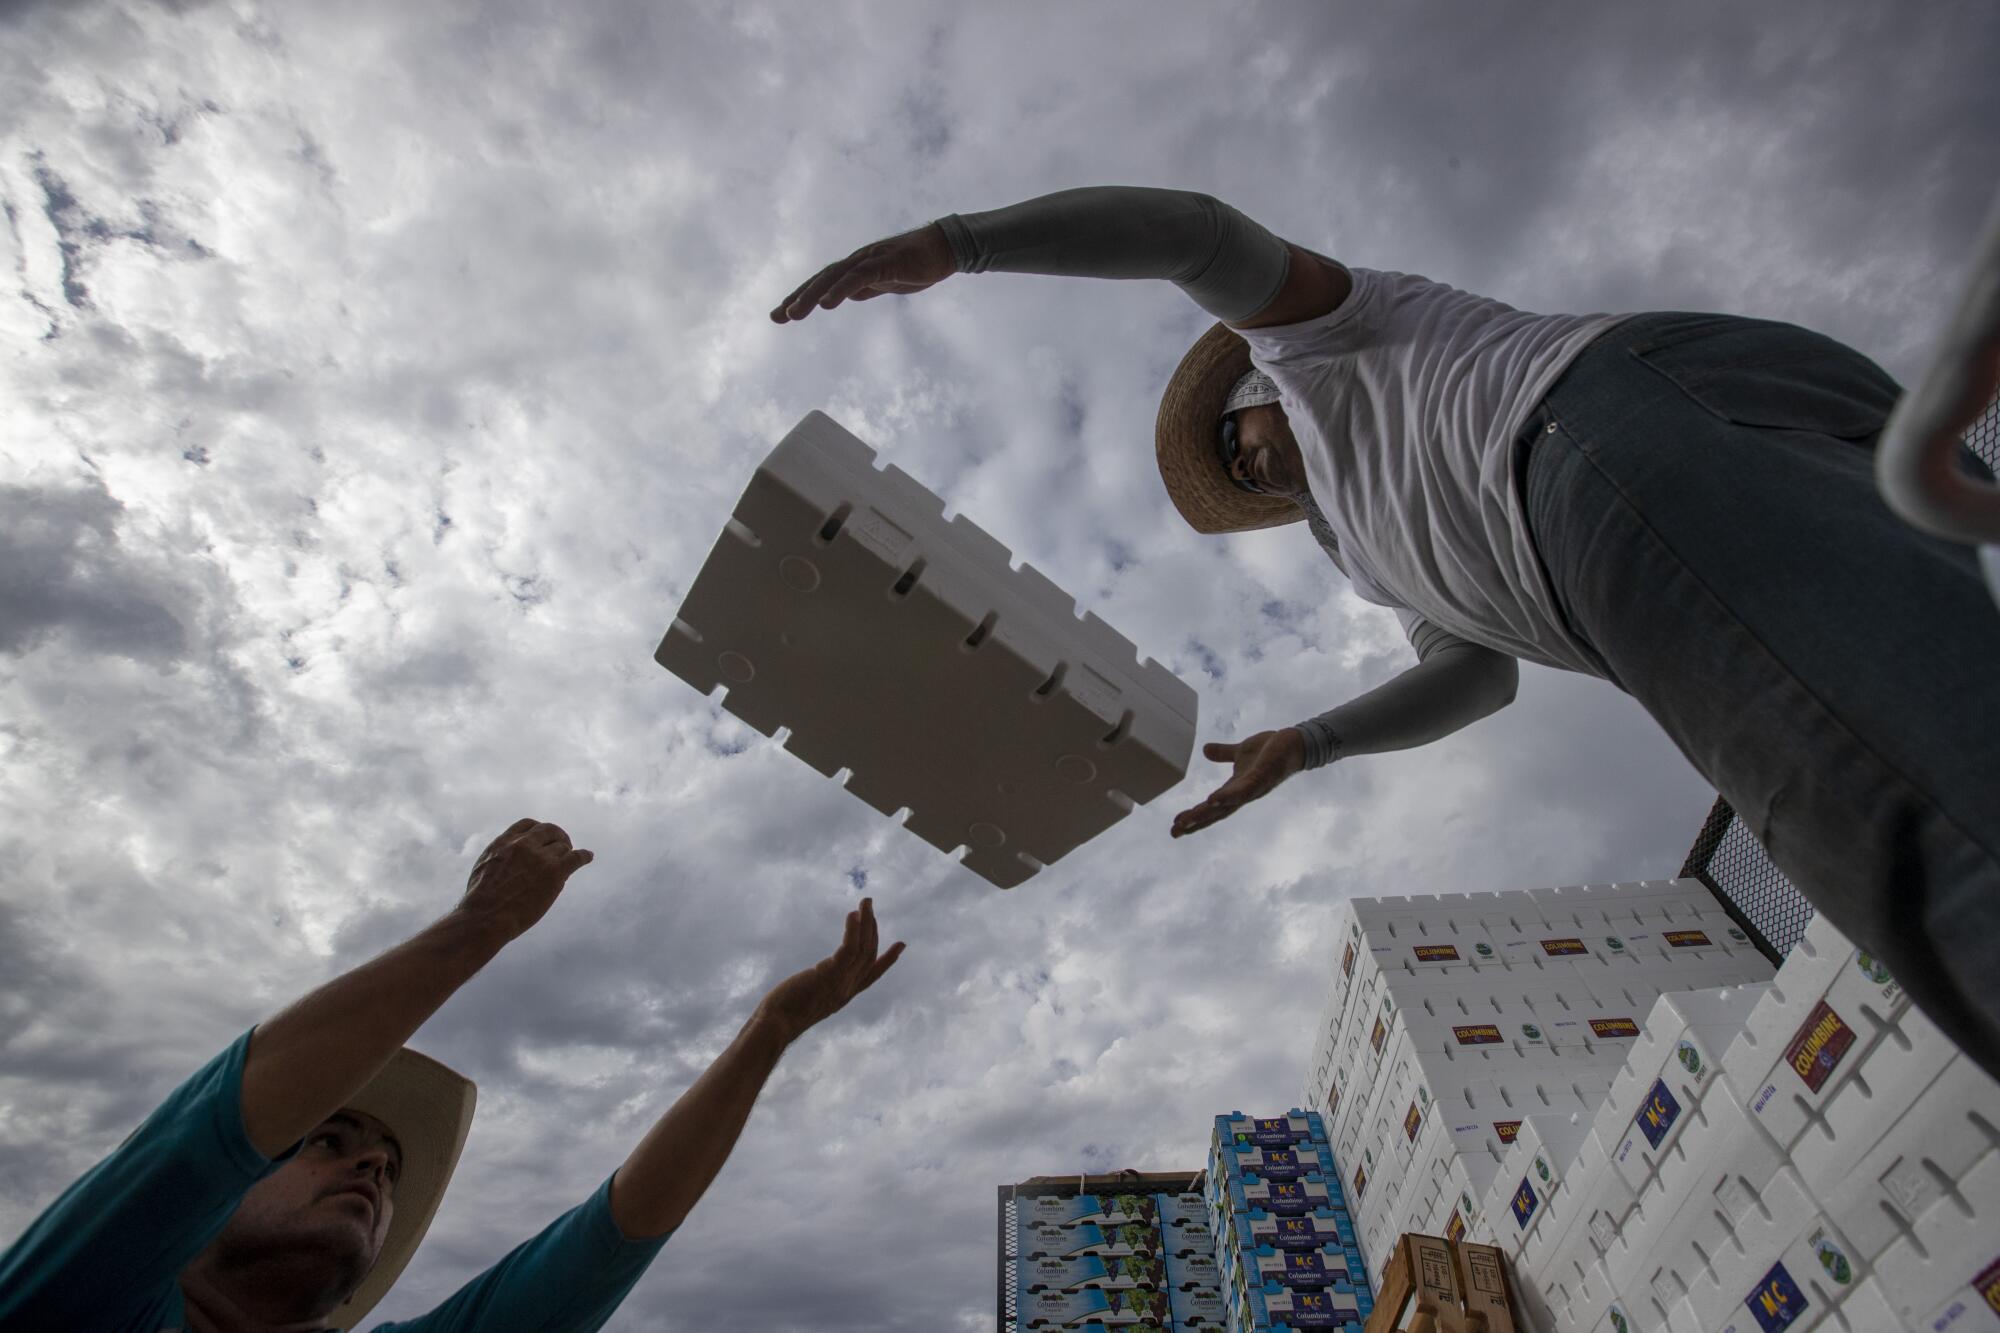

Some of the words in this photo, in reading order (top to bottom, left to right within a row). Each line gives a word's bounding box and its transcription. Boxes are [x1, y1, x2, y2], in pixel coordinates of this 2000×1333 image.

[1456, 1028, 1499, 1038] COLUMBINE
[1795, 1011, 1841, 1077] COLUMBINE
[1288, 1271, 1321, 1279] Columbine
[1036, 1300, 1070, 1308] Columbine
[1296, 1311, 1331, 1319] Columbine
